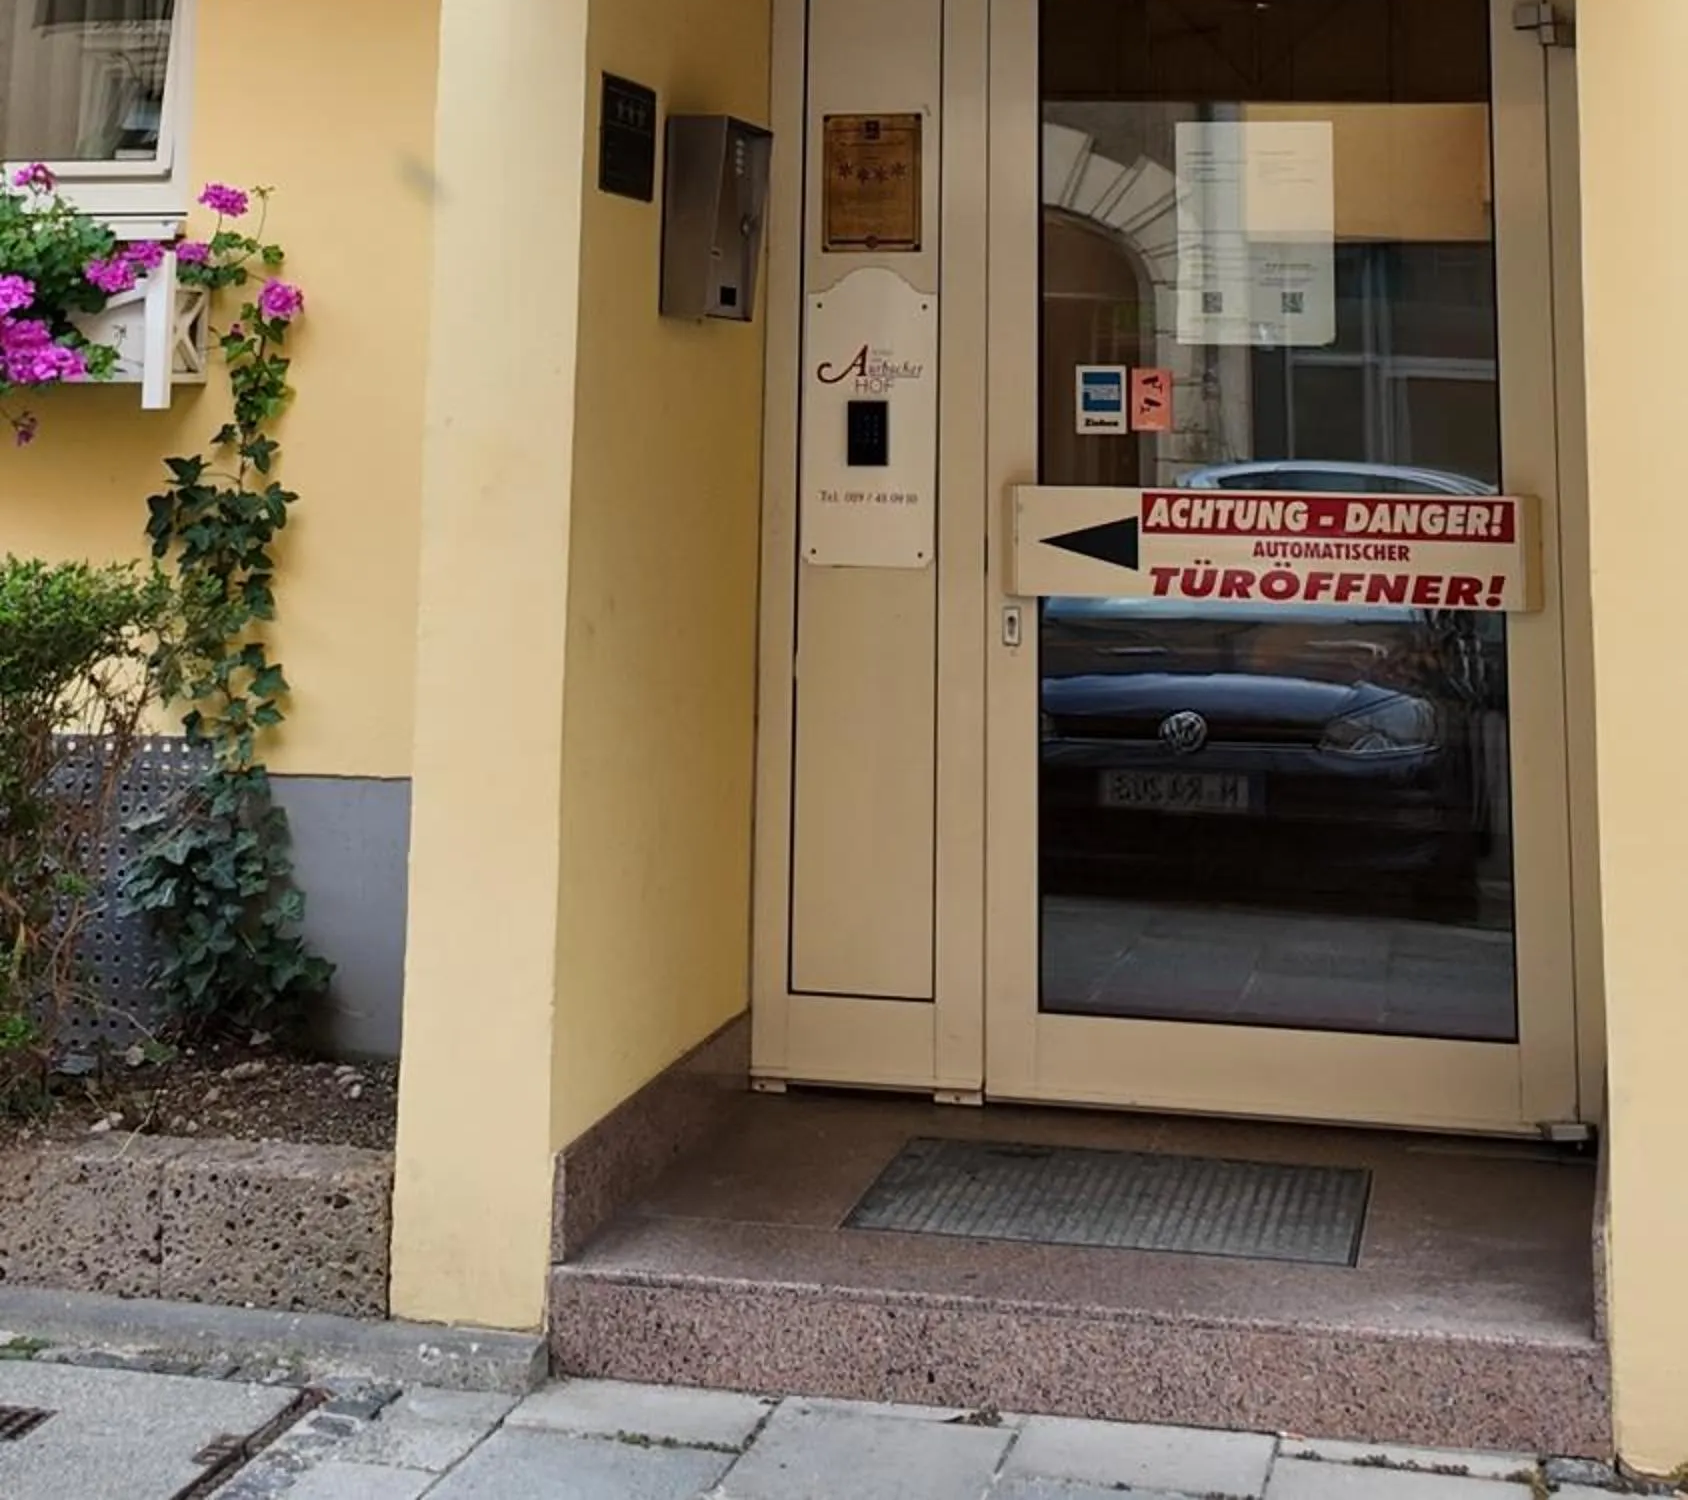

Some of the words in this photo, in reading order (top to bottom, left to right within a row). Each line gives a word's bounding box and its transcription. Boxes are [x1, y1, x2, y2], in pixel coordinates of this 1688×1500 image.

[1145, 497, 1309, 532] ACHTUNG
[1343, 501, 1504, 537] DANGER!
[1253, 540, 1411, 563] AUTOMATISCHER
[1150, 559, 1506, 608] TÜRÖFFNER!
